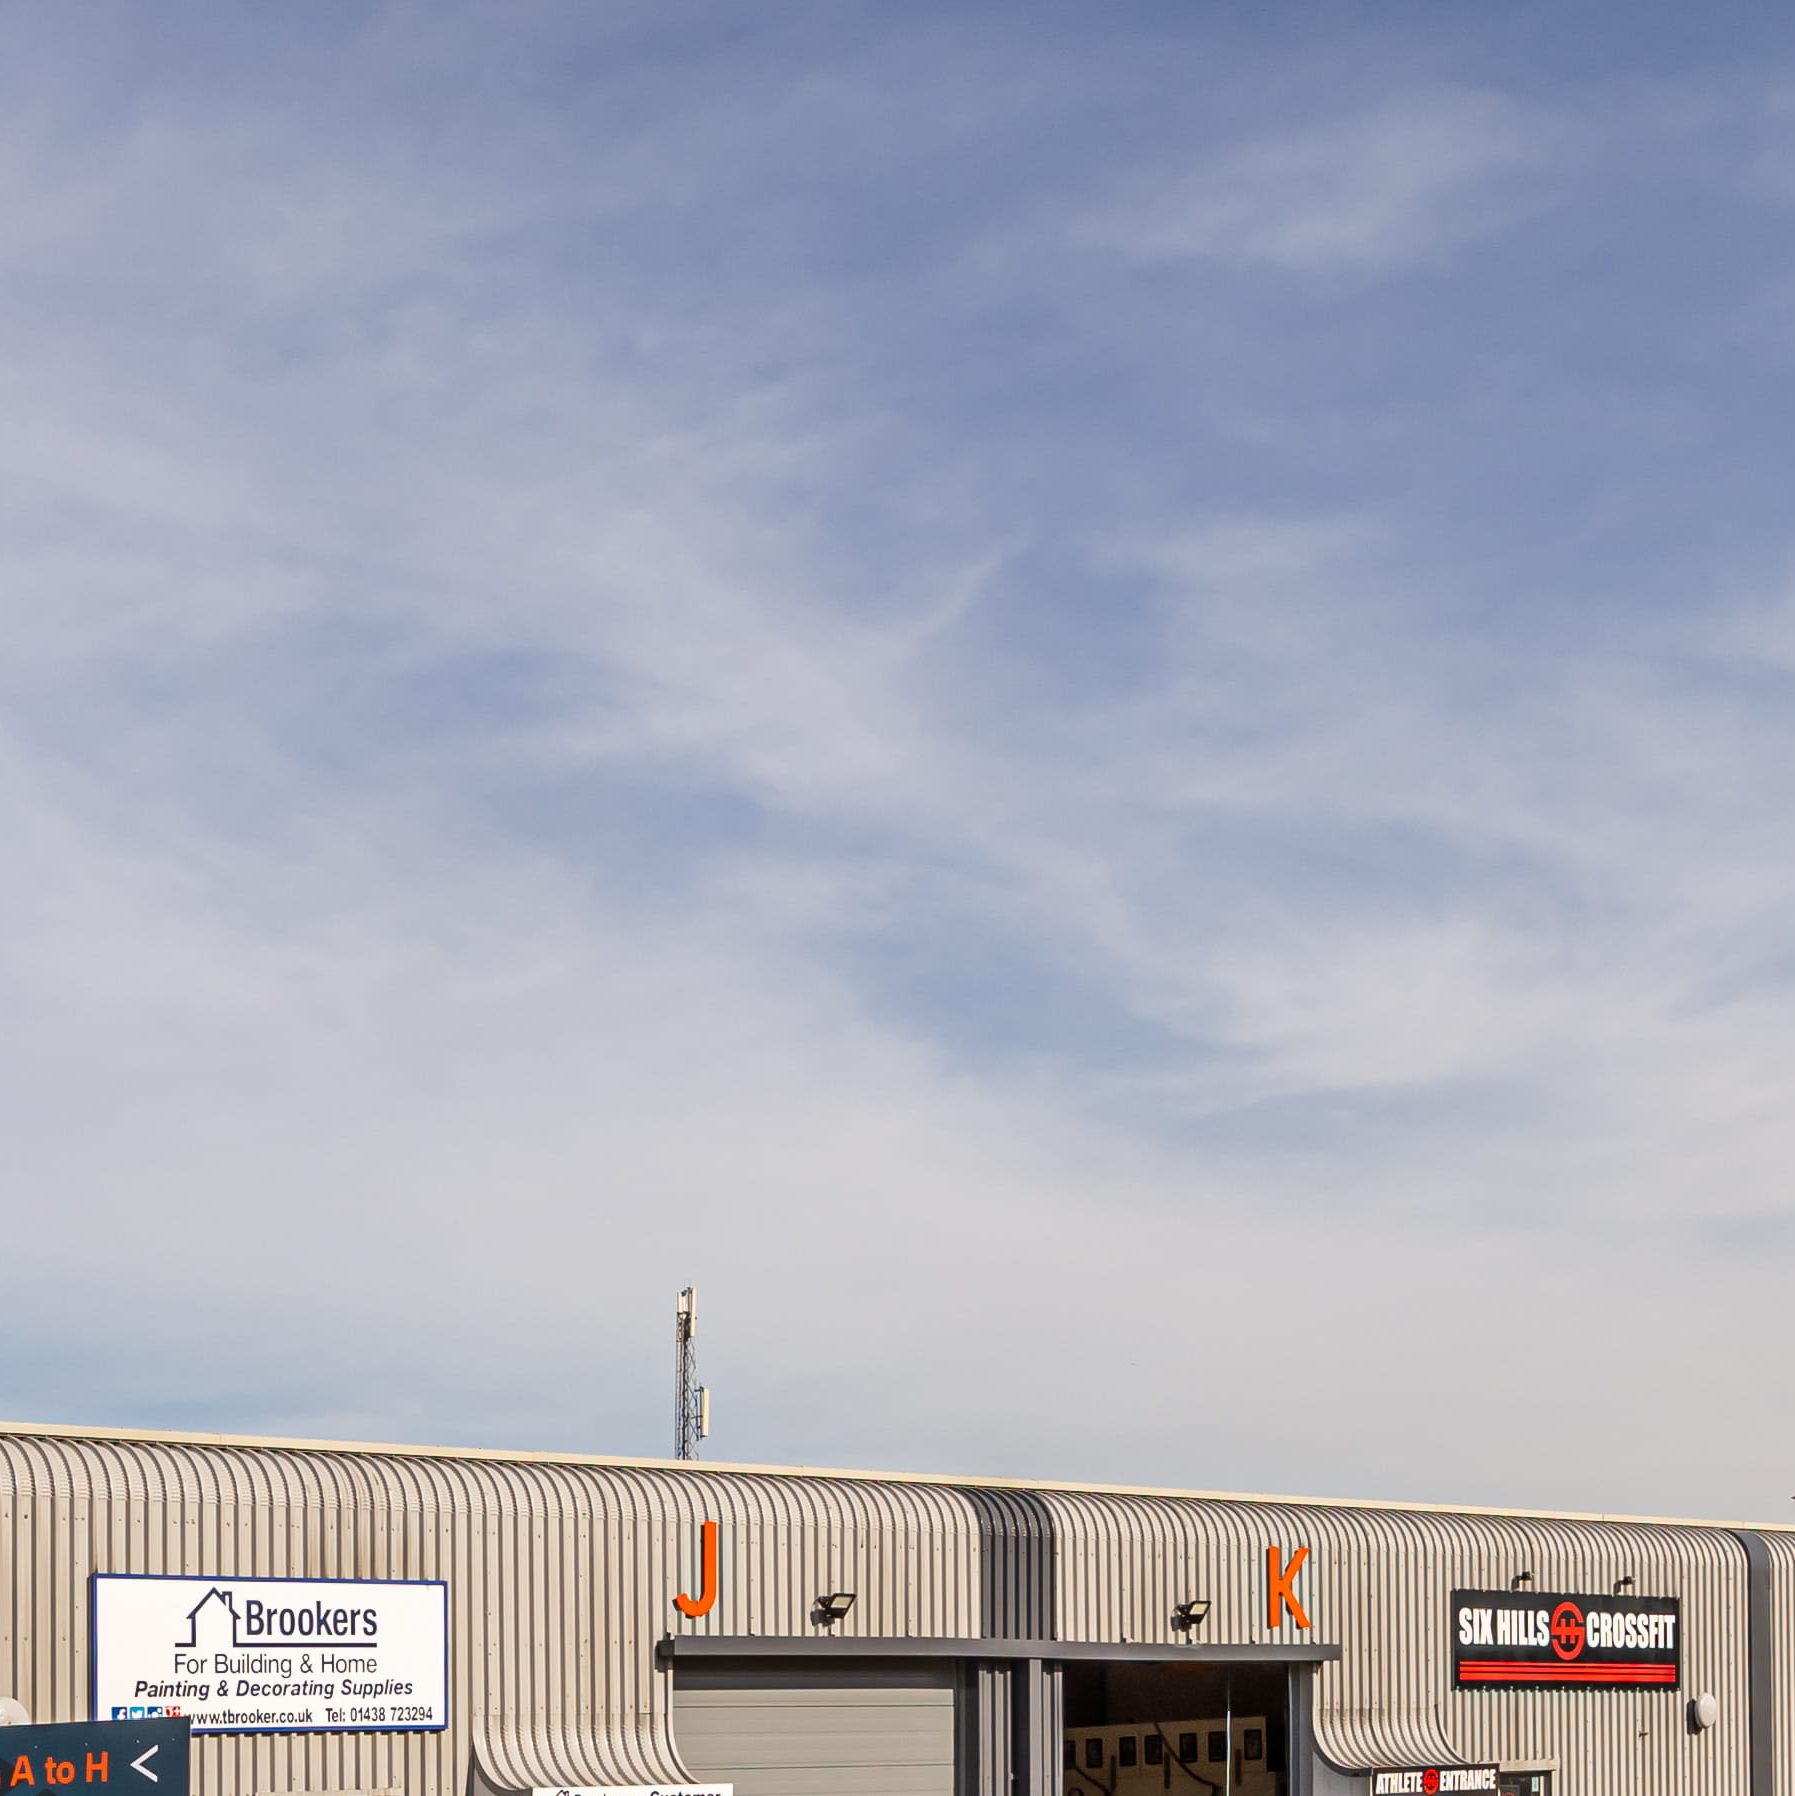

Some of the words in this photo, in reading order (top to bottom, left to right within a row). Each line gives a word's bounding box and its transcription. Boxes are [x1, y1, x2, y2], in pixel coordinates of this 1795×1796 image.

[674, 1520, 717, 1618] J
[1267, 1545, 1312, 1630] K
[245, 1599, 379, 1636] Brookers
[1459, 1607, 1494, 1646] SIX
[1497, 1609, 1550, 1647] HILLS
[1586, 1611, 1677, 1649] CROSSFIT
[174, 1653, 207, 1675] For
[214, 1653, 293, 1679] Building
[300, 1654, 314, 1674] &
[321, 1653, 378, 1674] Home
[134, 1679, 210, 1701] Painting
[217, 1680, 229, 1697] &
[236, 1679, 335, 1699] Decorating
[341, 1679, 414, 1699] Supplies
[325, 1708, 346, 1722] Tel:
[350, 1707, 386, 1723] 01438
[390, 1706, 433, 1722] 723294
[10, 1754, 35, 1787] A
[45, 1756, 75, 1785] to
[85, 1751, 109, 1783] H
[1375, 1771, 1423, 1795] ATHLETE
[1439, 1769, 1497, 1792] ENTRANCE
